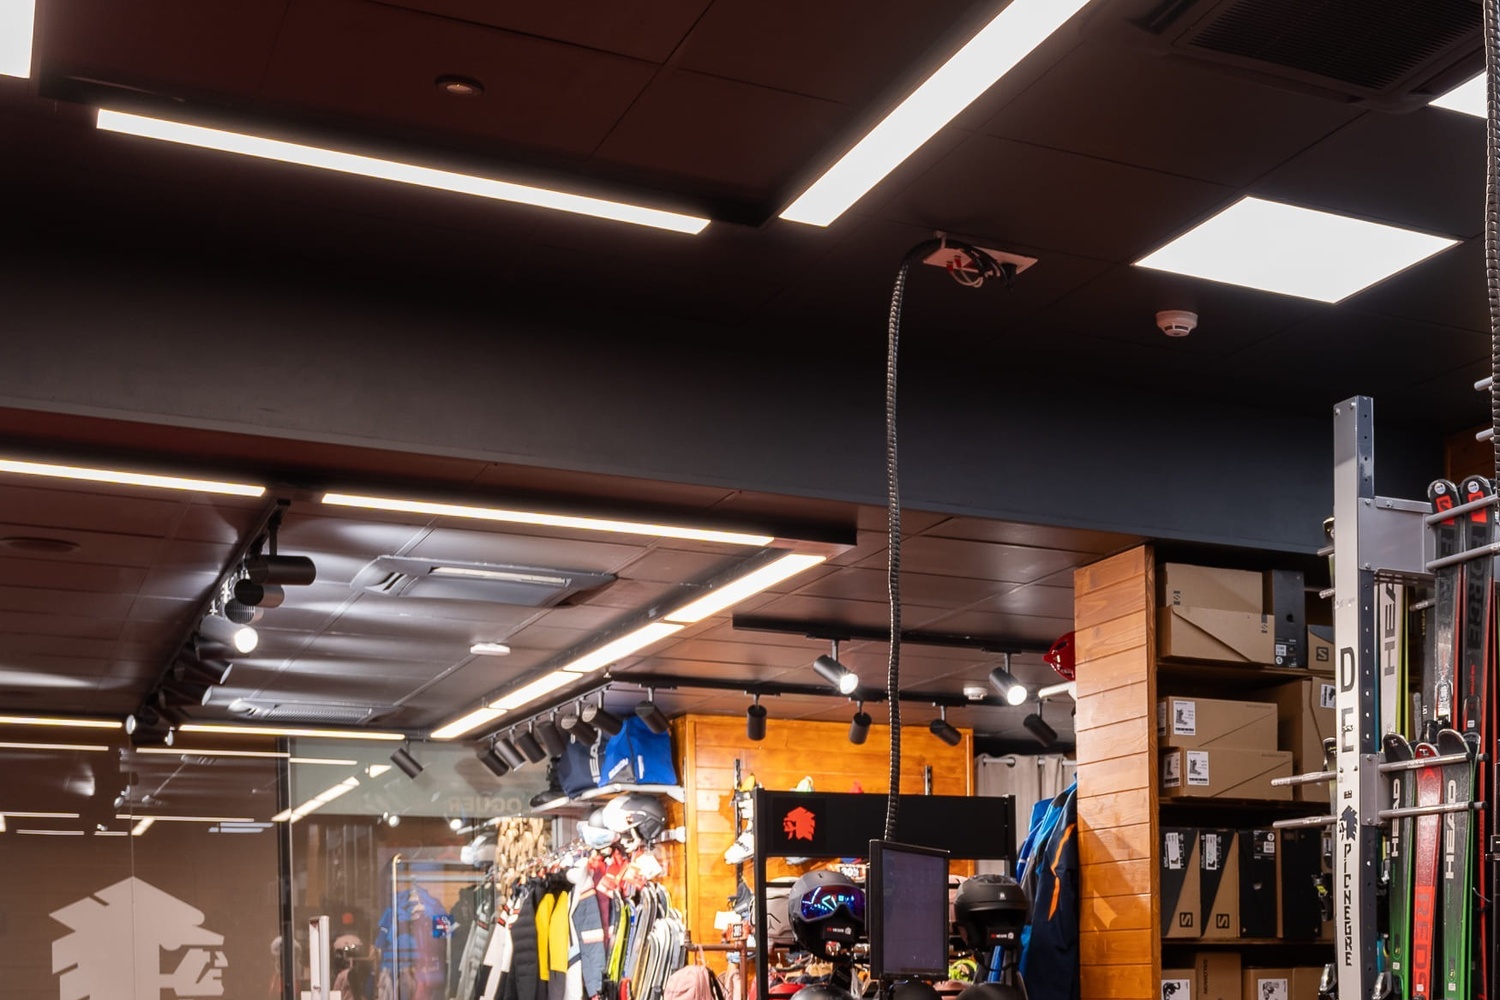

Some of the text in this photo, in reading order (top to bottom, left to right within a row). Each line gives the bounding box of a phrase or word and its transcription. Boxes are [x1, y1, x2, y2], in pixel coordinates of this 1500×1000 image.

[1384, 583, 1396, 676] HEA
[1340, 646, 1356, 693] D
[1341, 707, 1354, 753] E
[1446, 780, 1456, 879] HEAD
